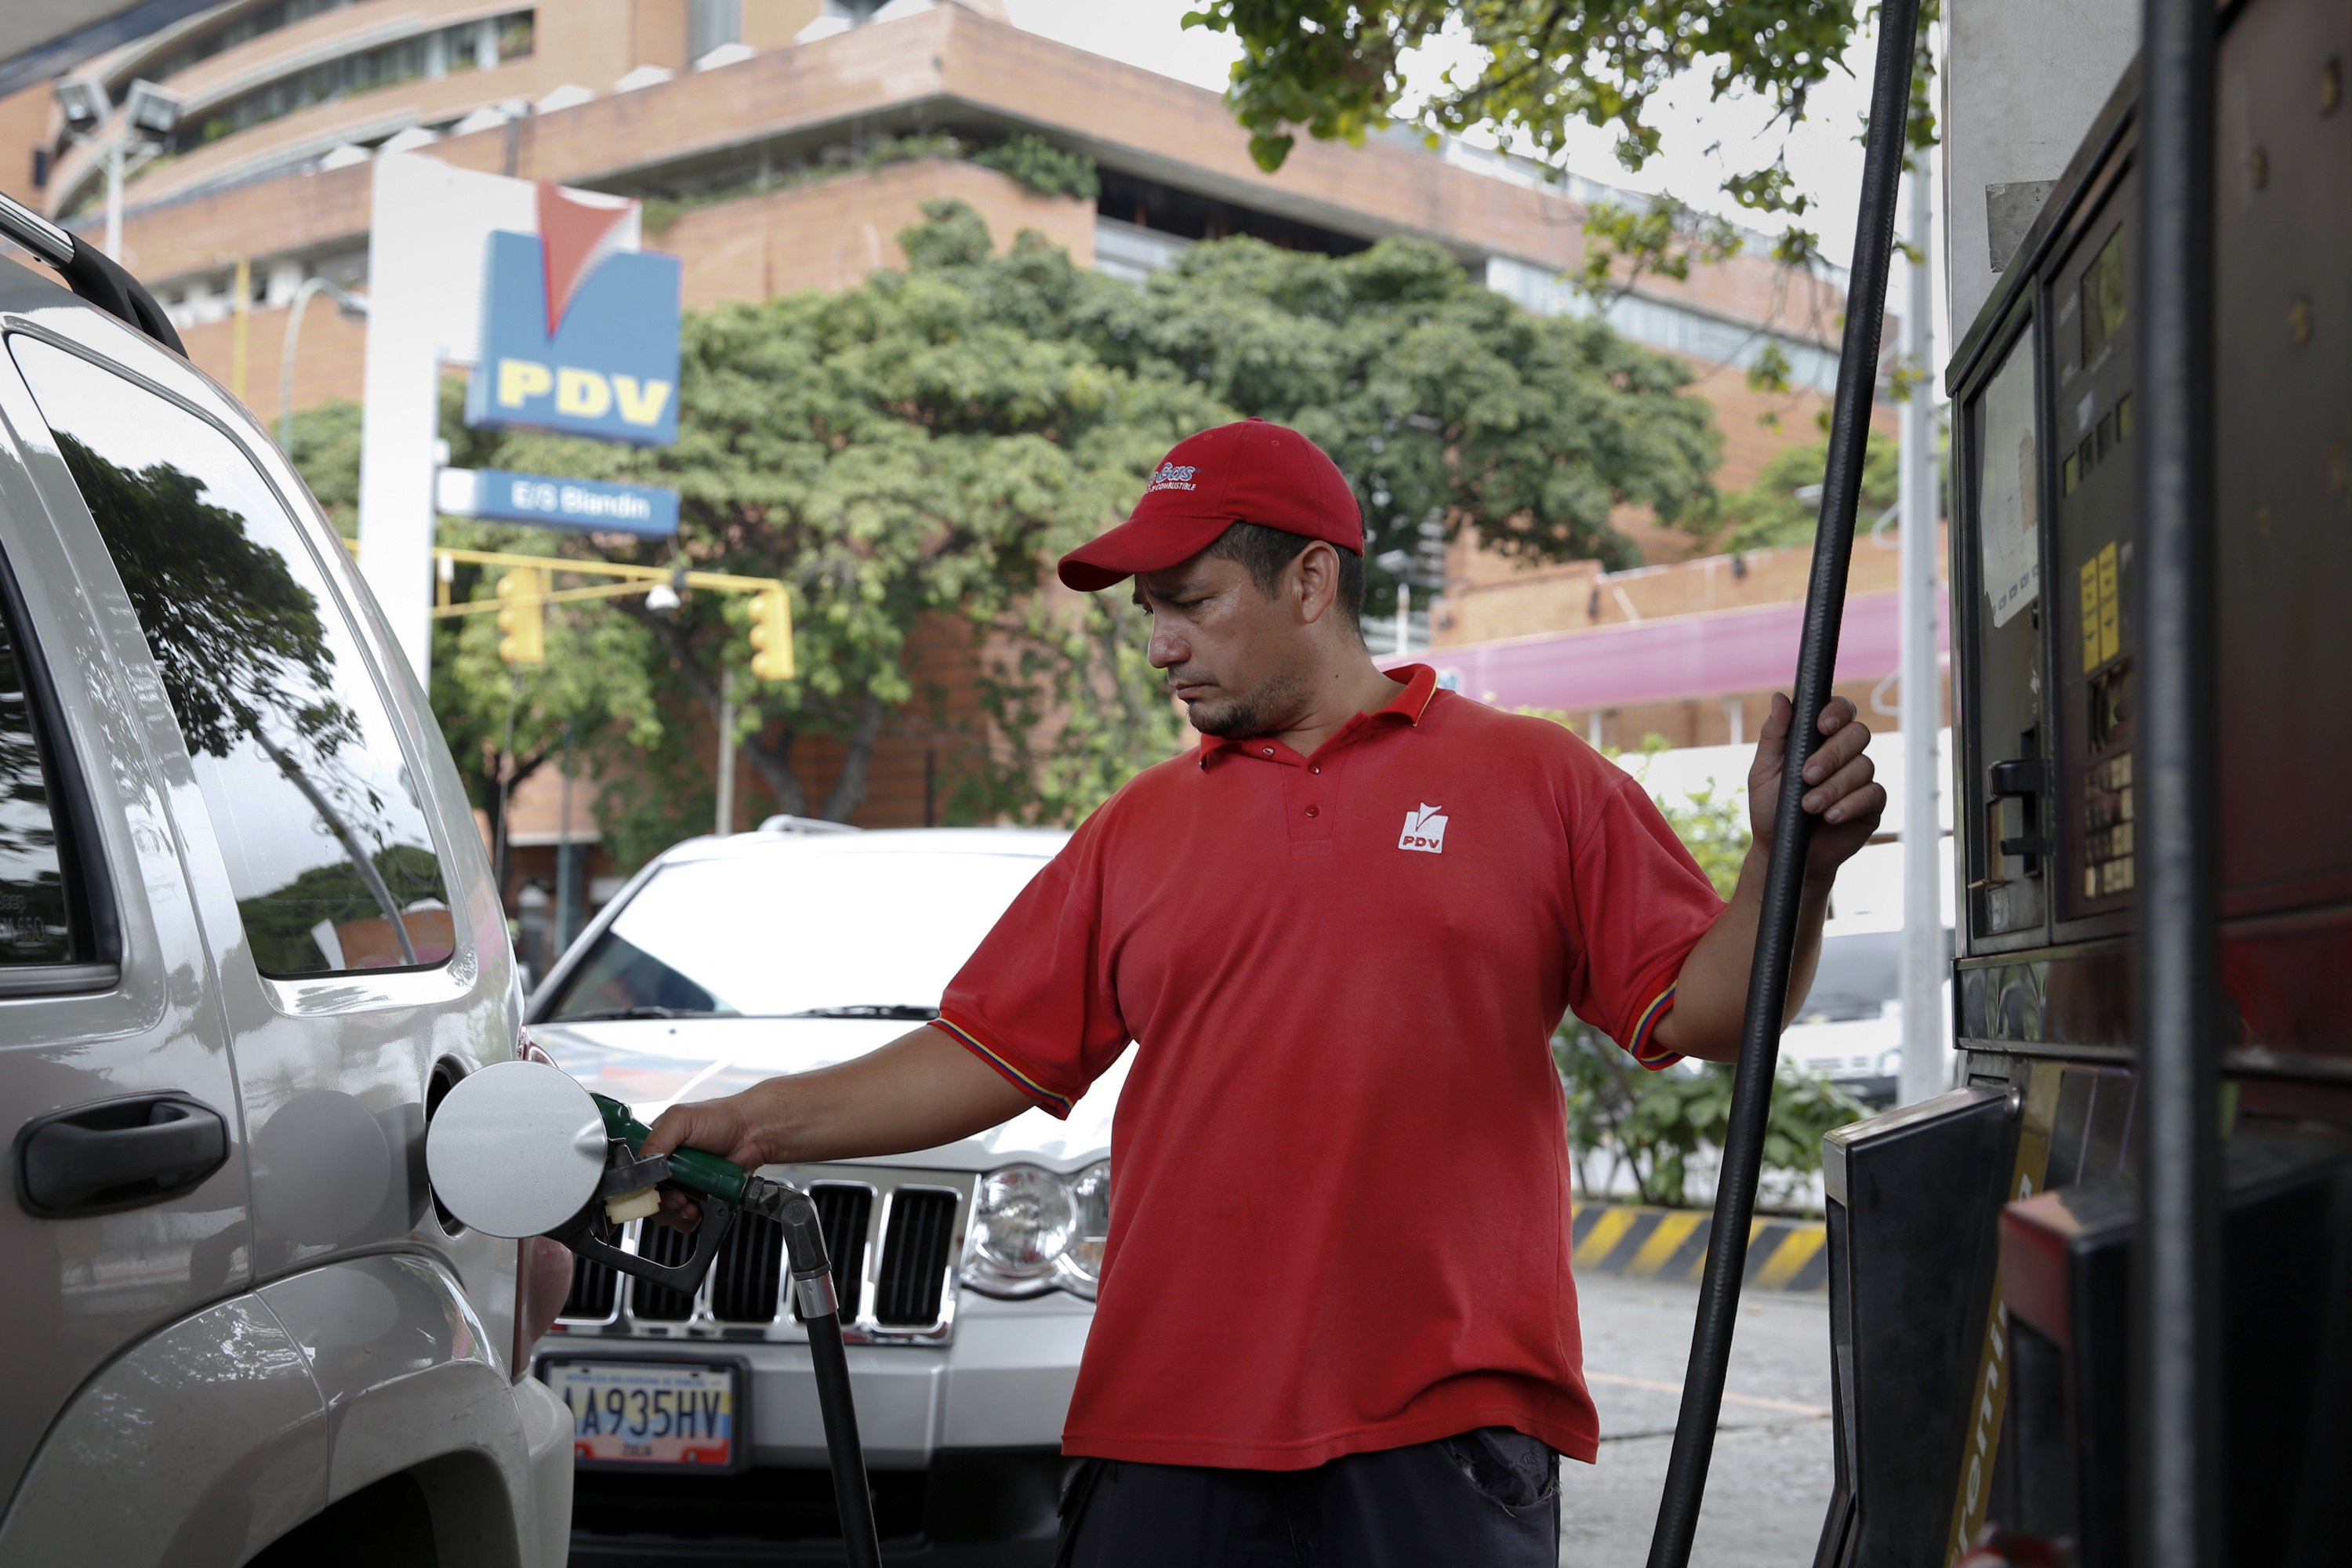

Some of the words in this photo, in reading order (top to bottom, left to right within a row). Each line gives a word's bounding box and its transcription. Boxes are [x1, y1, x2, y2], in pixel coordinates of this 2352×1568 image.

[497, 358, 672, 426] PDV
[511, 481, 558, 512] E/S
[1156, 481, 1197, 491] COMBUSTIBLE
[1403, 836, 1439, 848] PDV
